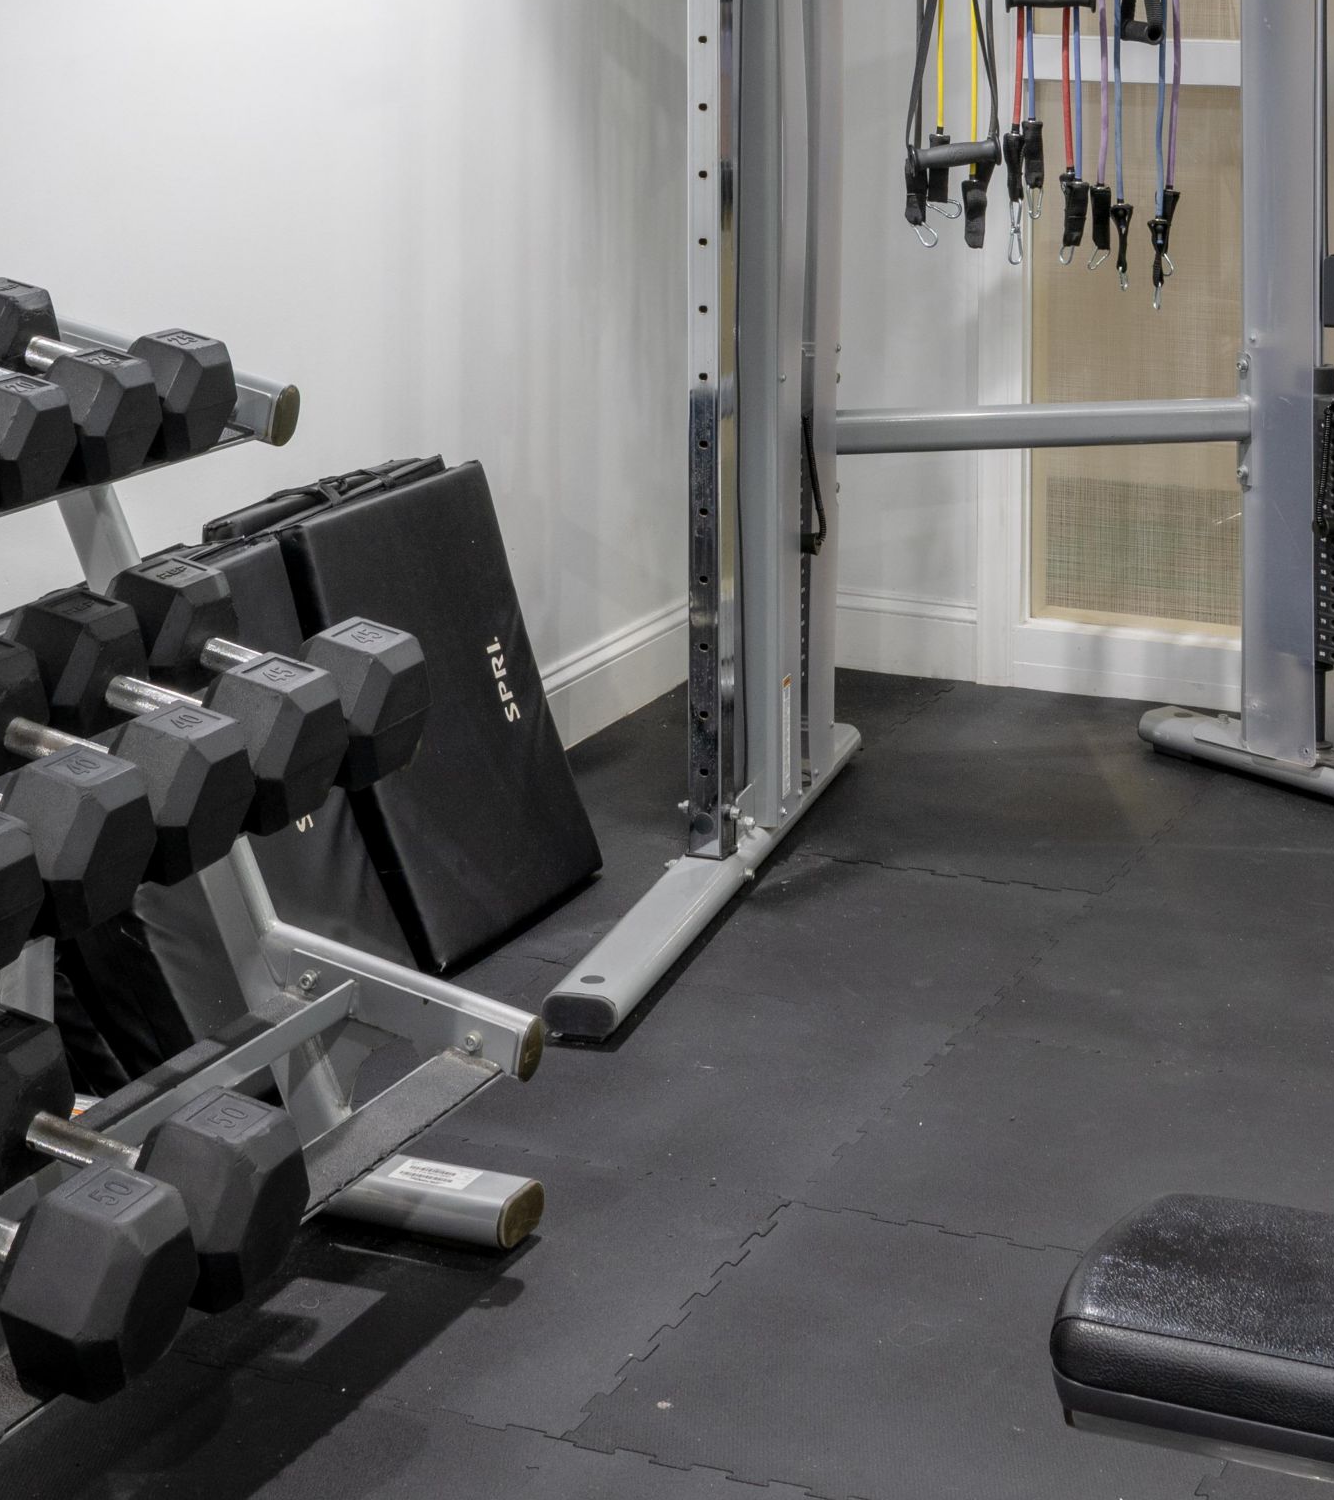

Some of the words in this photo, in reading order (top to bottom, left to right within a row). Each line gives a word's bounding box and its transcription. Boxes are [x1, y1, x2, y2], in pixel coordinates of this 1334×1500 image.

[348, 626, 383, 646] 45
[262, 664, 296, 683] 45
[171, 713, 203, 730] 40
[67, 757, 100, 776] 40
[208, 1105, 247, 1131] 50
[89, 1179, 134, 1207] 50
